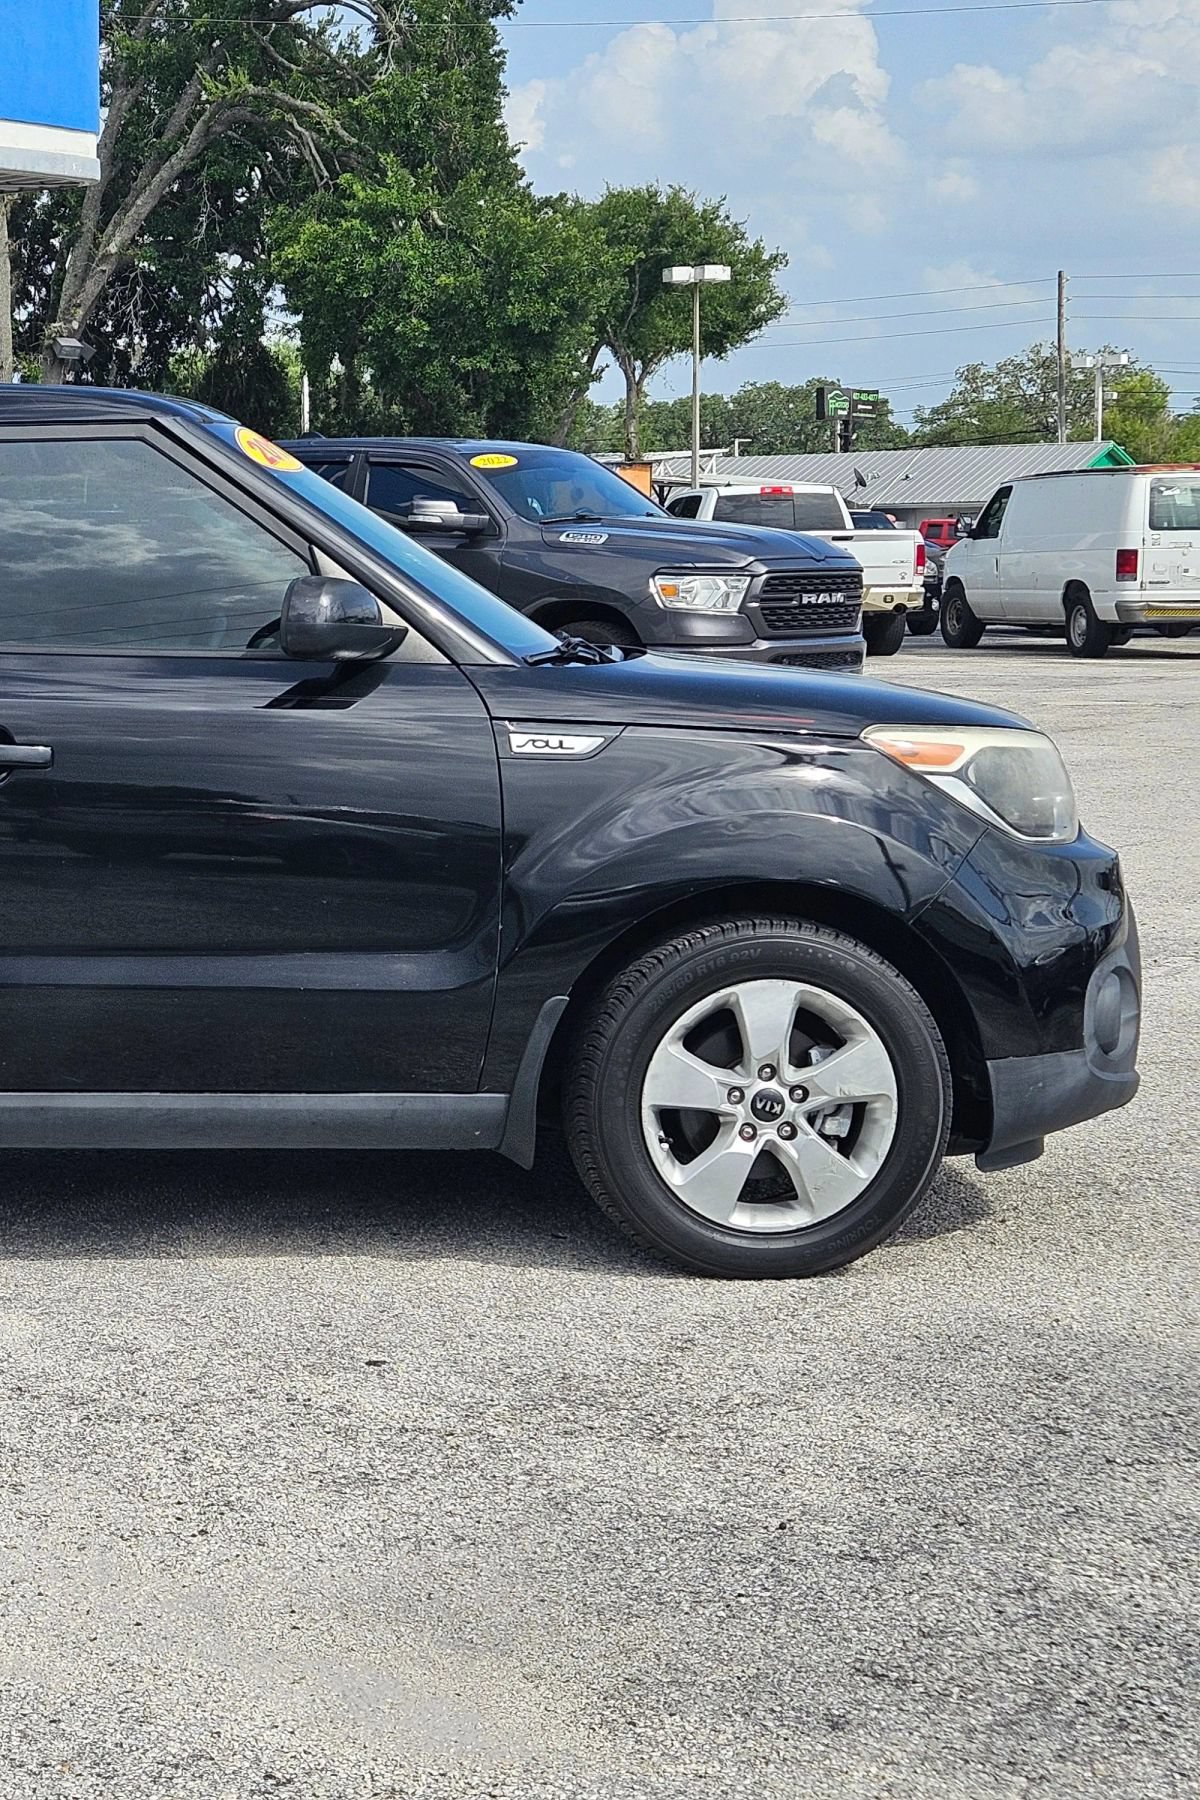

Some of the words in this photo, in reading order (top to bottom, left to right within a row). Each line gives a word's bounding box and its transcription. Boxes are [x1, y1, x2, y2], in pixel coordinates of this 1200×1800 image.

[479, 456, 509, 466] 2022
[802, 592, 846, 604] RAM
[516, 738, 575, 750] SOUL
[696, 956, 727, 977] R16
[730, 948, 762, 963] 92V
[756, 1096, 782, 1115] KIA
[827, 1214, 881, 1252] TOURING
